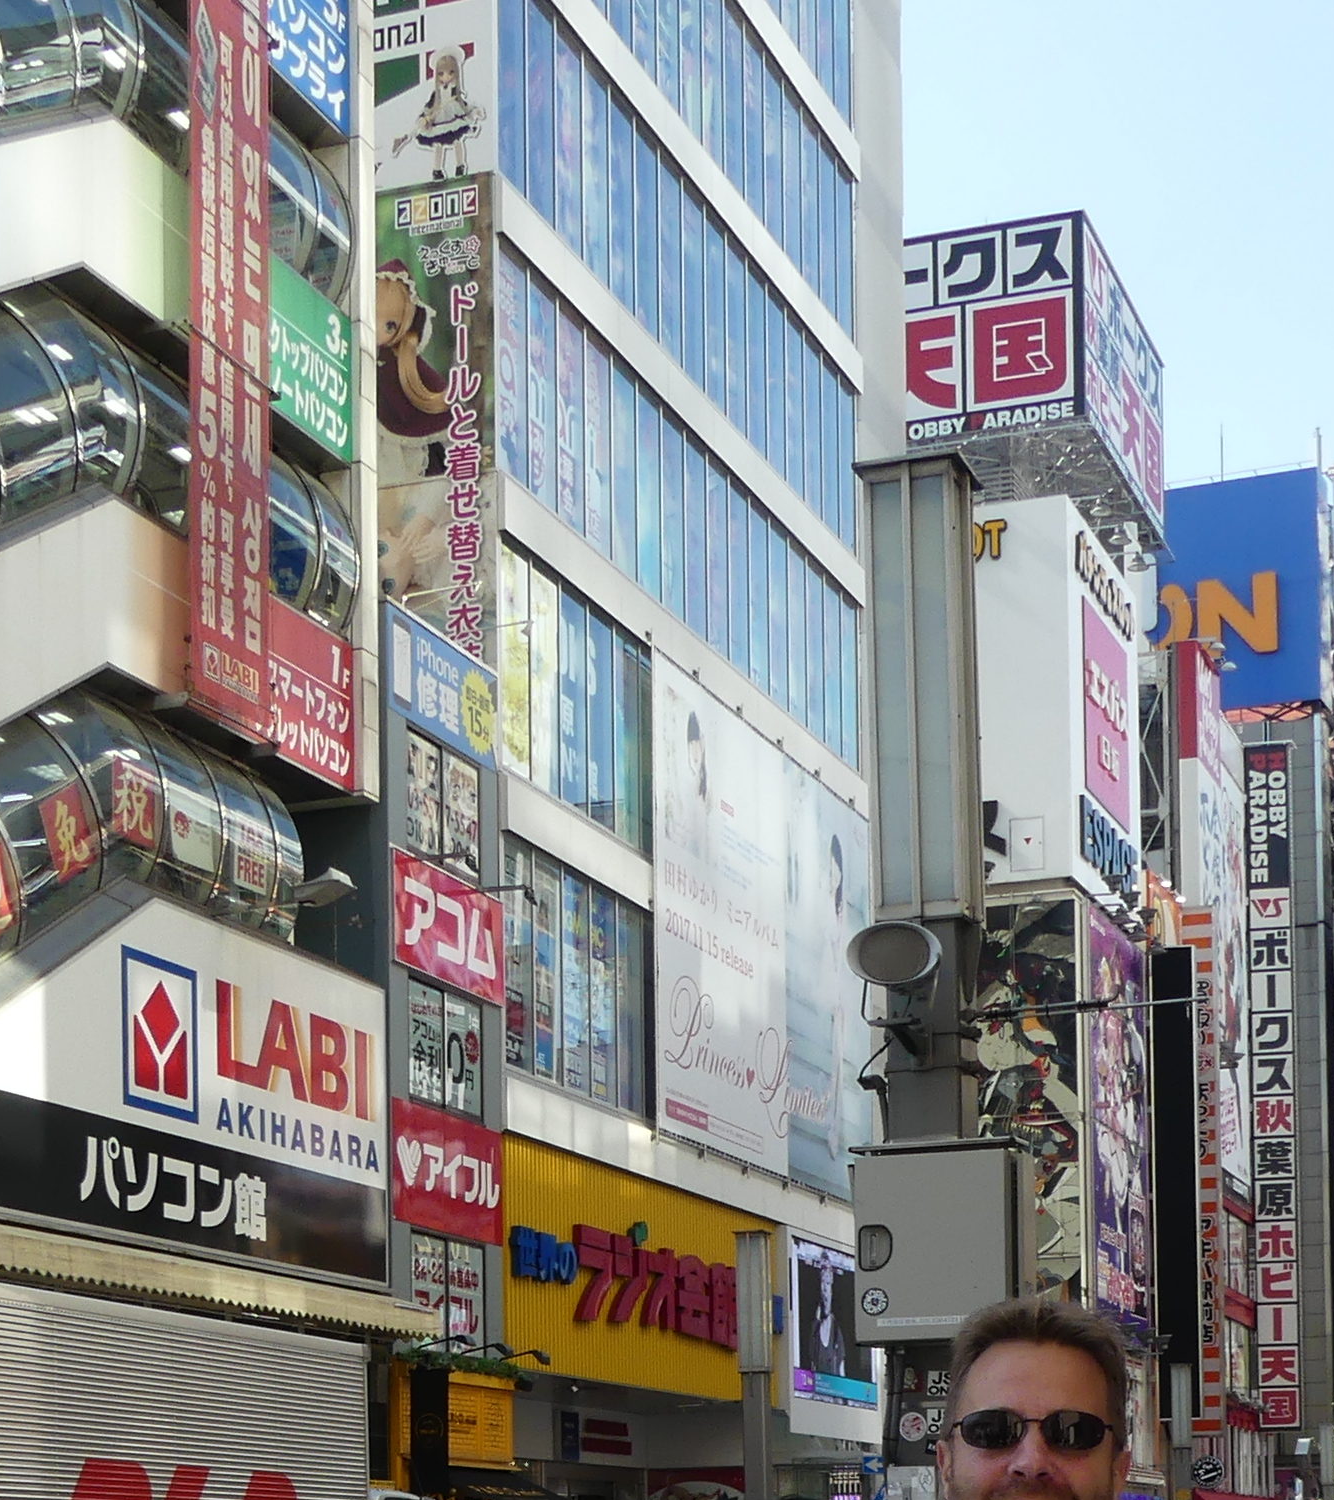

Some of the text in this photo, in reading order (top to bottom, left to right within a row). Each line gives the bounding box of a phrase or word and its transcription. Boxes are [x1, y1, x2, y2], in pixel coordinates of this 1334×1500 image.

[326, 313, 348, 359] 3F
[242, 319, 262, 478] 면세
[242, 497, 262, 656] 상점
[331, 644, 351, 691] 1F
[417, 637, 460, 687] iPhone
[416, 667, 460, 735] 修理
[237, 856, 266, 890] FREE
[404, 876, 498, 980] アコム
[665, 907, 755, 980] 2017.11.15 release
[215, 978, 376, 1123] LABI
[215, 1096, 380, 1175] AKIHABARA
[78, 1134, 268, 1243] パソコン館
[423, 1147, 501, 1211] アイフル
[511, 1220, 738, 1353] 世界の ラジオ会館
